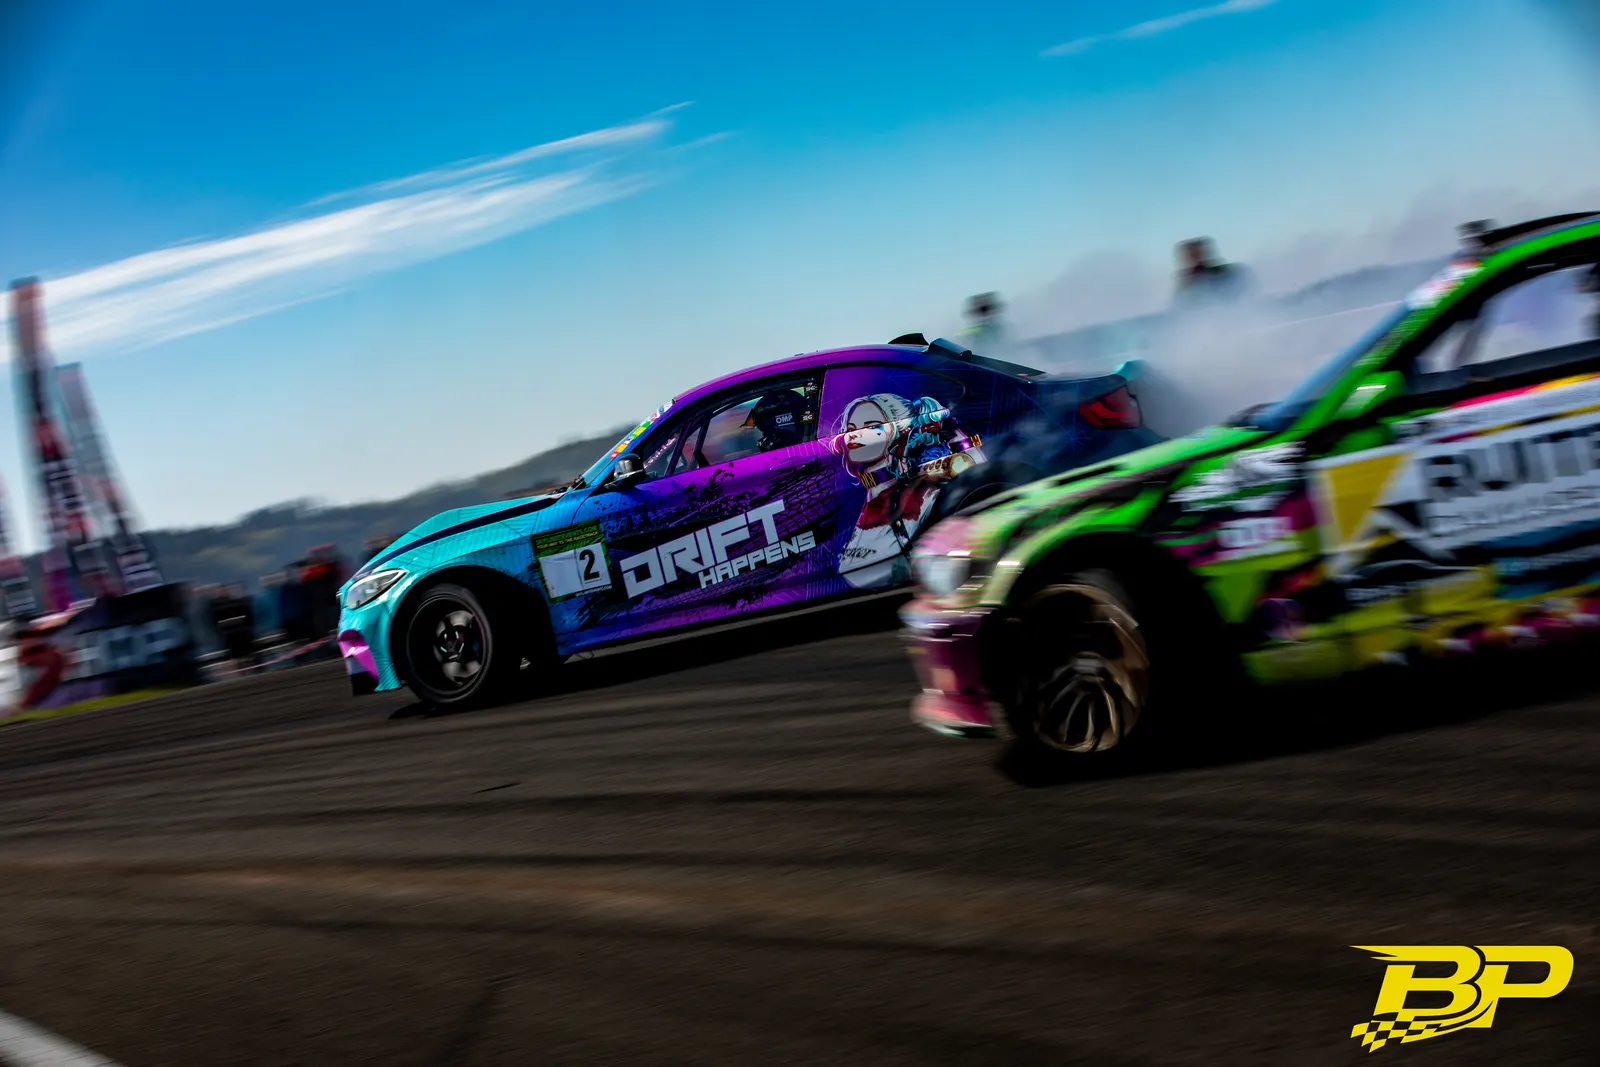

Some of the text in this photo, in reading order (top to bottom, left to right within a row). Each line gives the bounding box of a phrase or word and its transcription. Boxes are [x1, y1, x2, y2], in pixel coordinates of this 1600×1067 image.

[775, 414, 793, 424] OMP
[1417, 421, 1600, 502] RUTT
[579, 549, 600, 581] 2
[620, 499, 785, 599] DRIFT
[698, 530, 816, 590] HAPPENS
